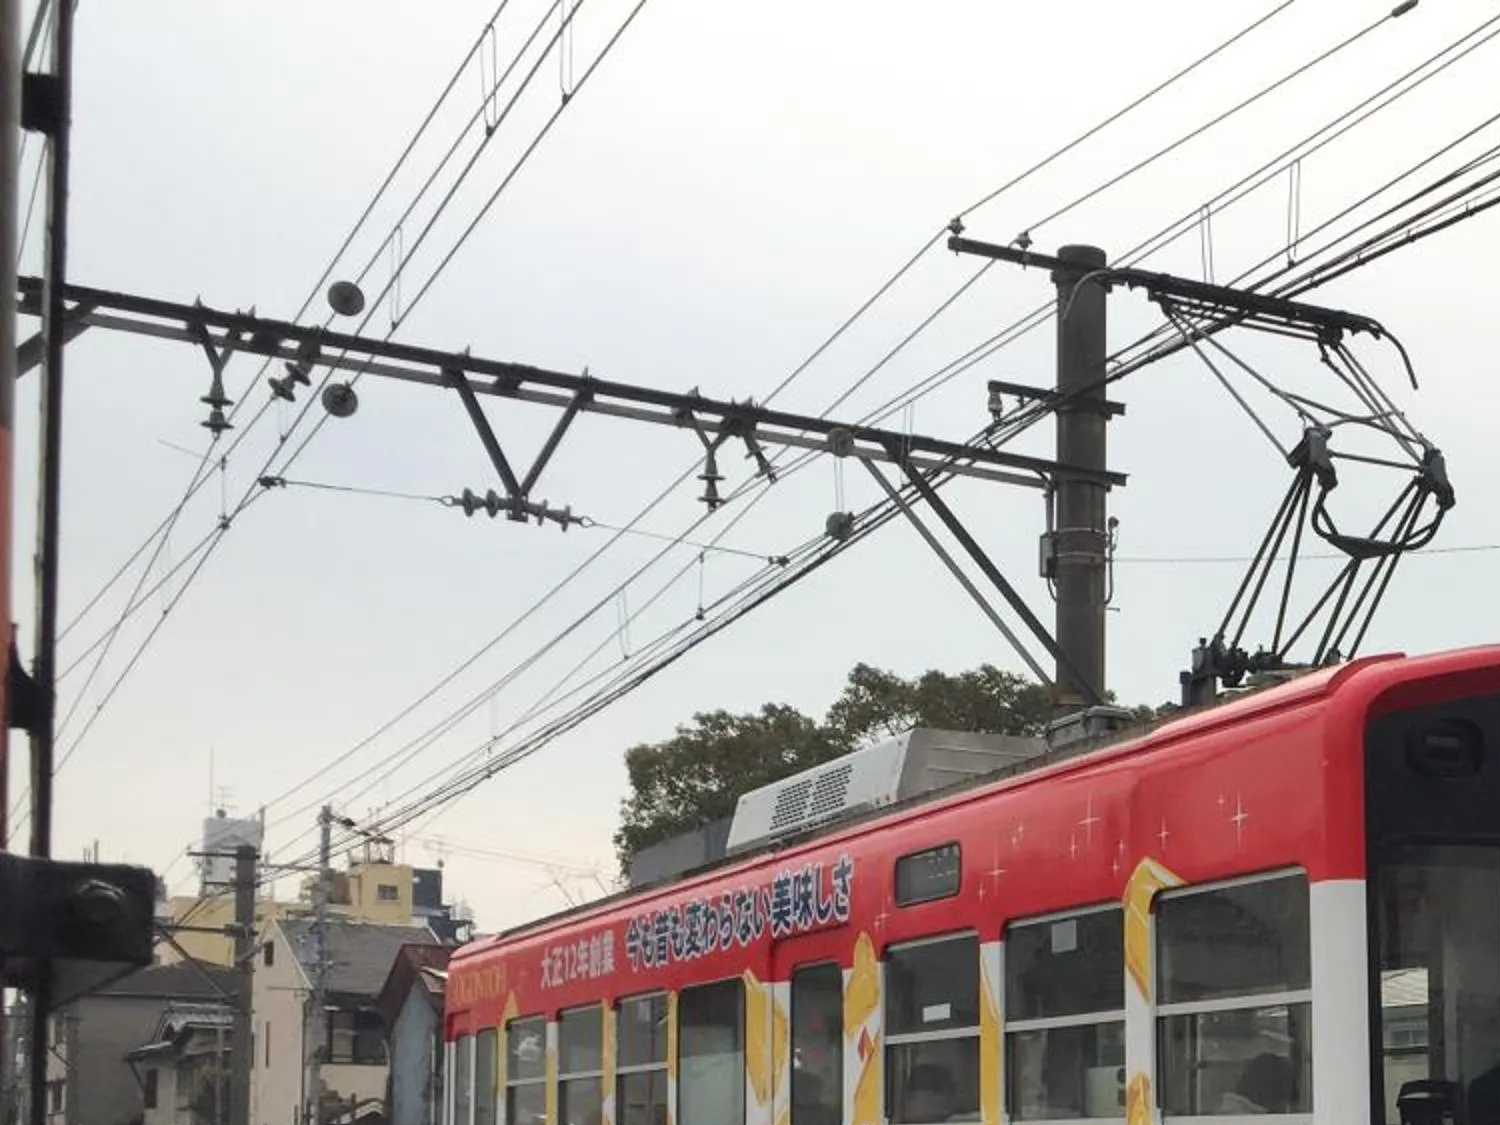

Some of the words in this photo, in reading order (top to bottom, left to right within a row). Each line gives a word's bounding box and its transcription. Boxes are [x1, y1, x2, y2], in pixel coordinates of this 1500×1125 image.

[626, 853, 854, 972] 今も昔も変わらない美味しさ
